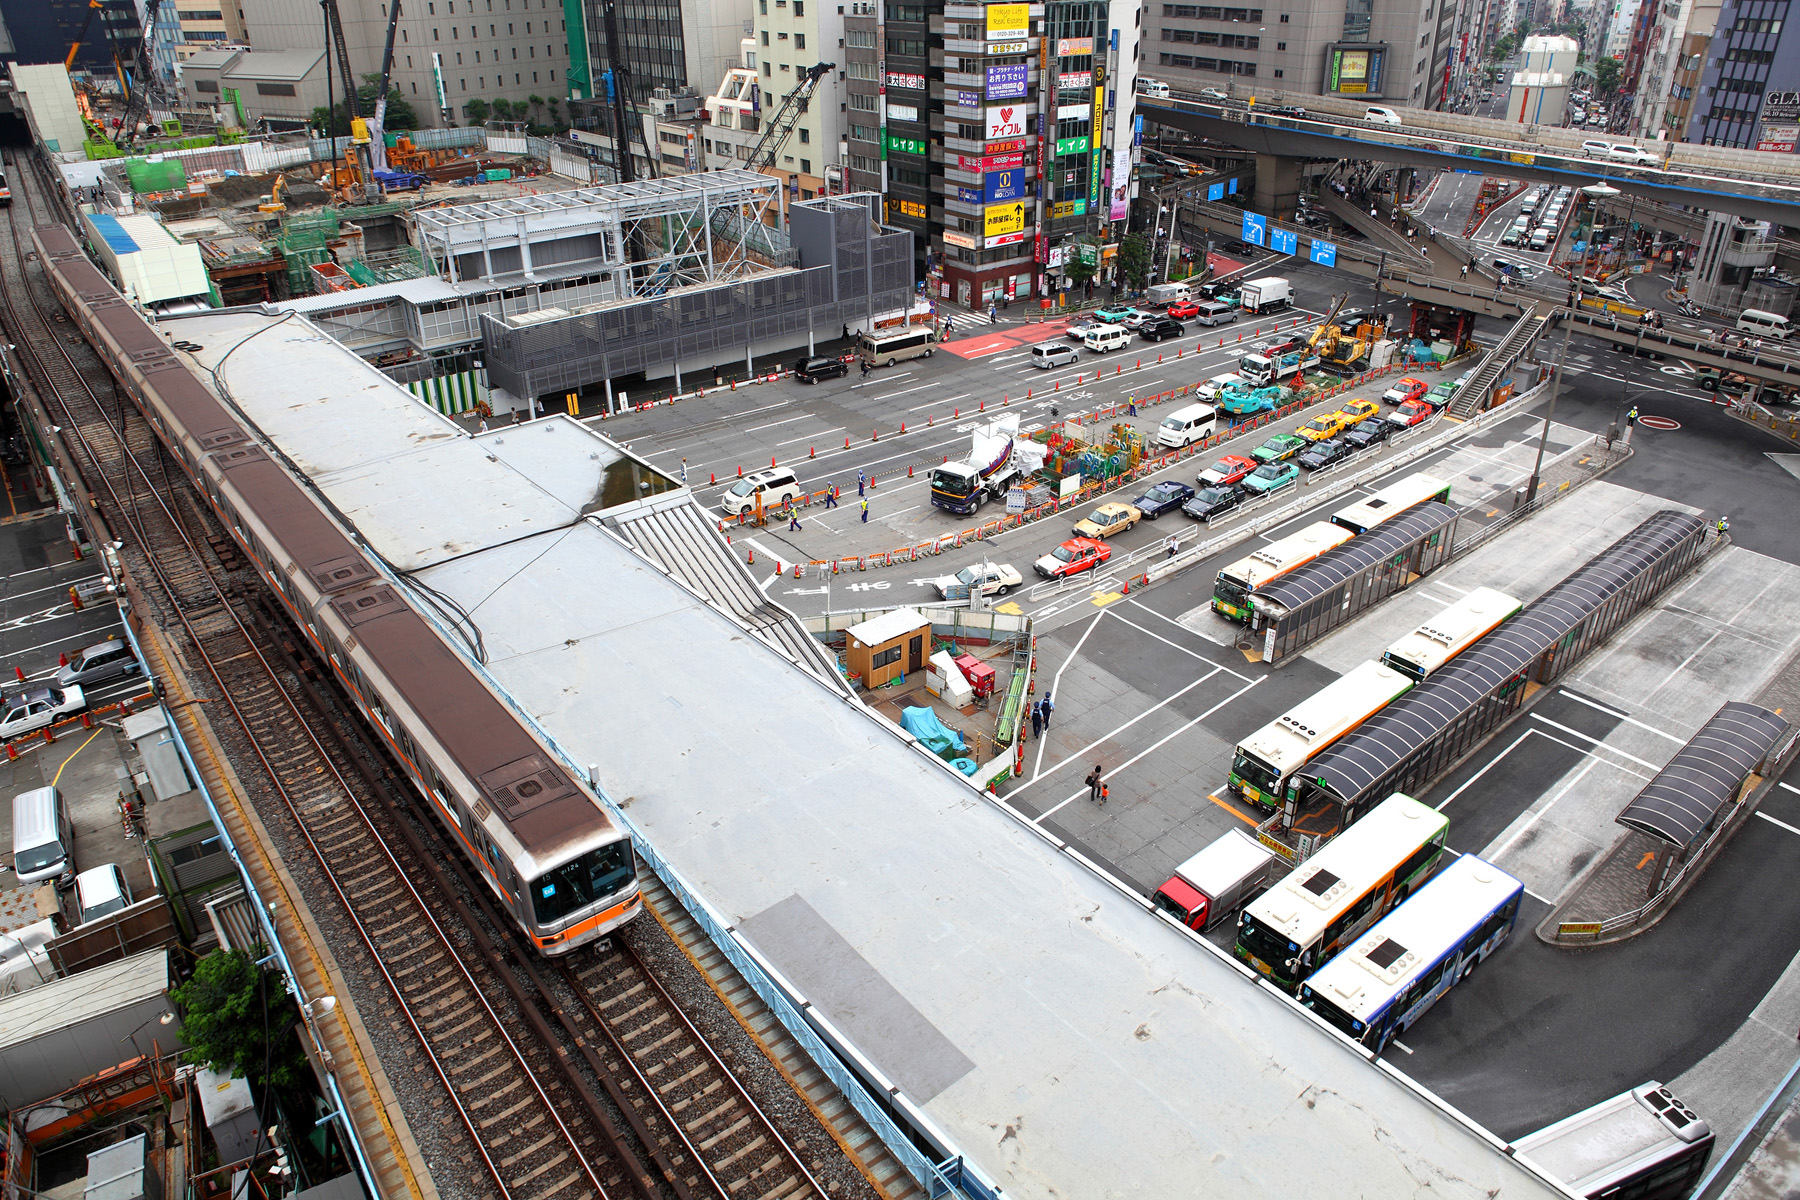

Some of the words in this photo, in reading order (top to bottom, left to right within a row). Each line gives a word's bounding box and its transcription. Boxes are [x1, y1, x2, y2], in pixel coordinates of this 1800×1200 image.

[993, 8, 1010, 18] Tokyo
[1012, 6, 1022, 16] Life
[887, 76, 925, 89] 東大さくら塾
[989, 73, 1024, 83] お売り下さい
[992, 123, 1021, 137] アイフル
[892, 138, 914, 150] レイク
[1057, 139, 1086, 153] レイク
[1758, 143, 1793, 151] 資格の大原
[988, 215, 1014, 225] お部屋探し
